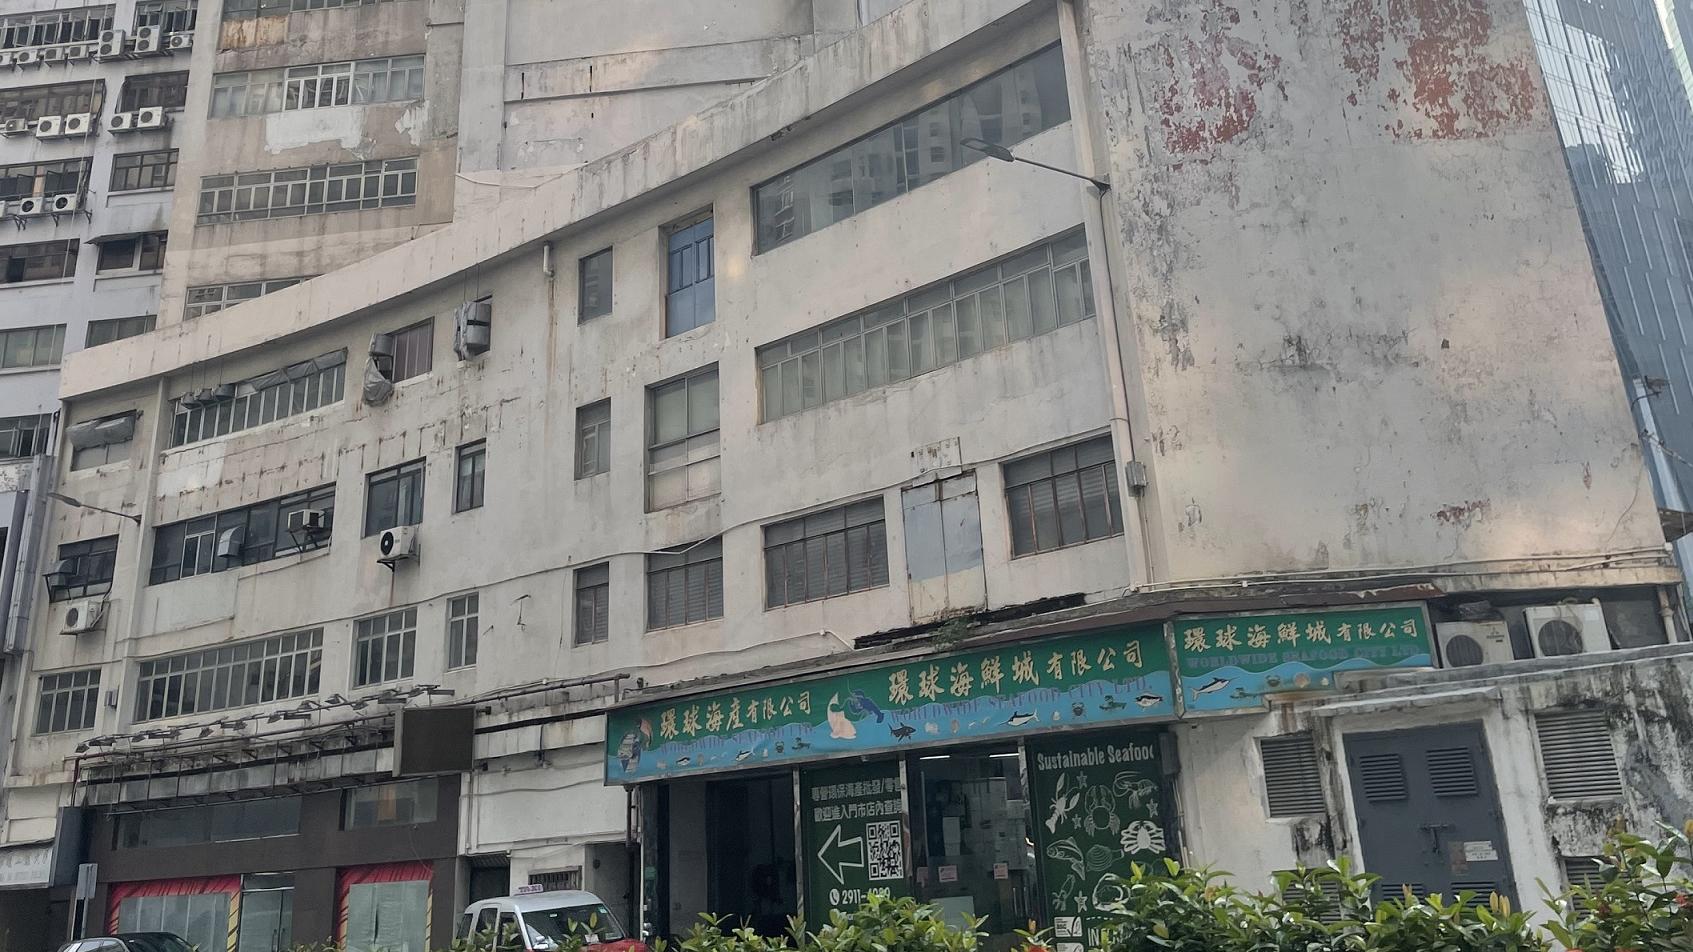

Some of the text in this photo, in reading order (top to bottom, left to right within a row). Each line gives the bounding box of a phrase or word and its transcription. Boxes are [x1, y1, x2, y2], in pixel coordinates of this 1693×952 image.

[1184, 619, 1418, 653] 環球海鮮城有限公司
[888, 640, 1144, 706] 環球海鮮城有限公司
[659, 690, 812, 740] 環球海產有限公司
[1037, 746, 1106, 771] Sustainable
